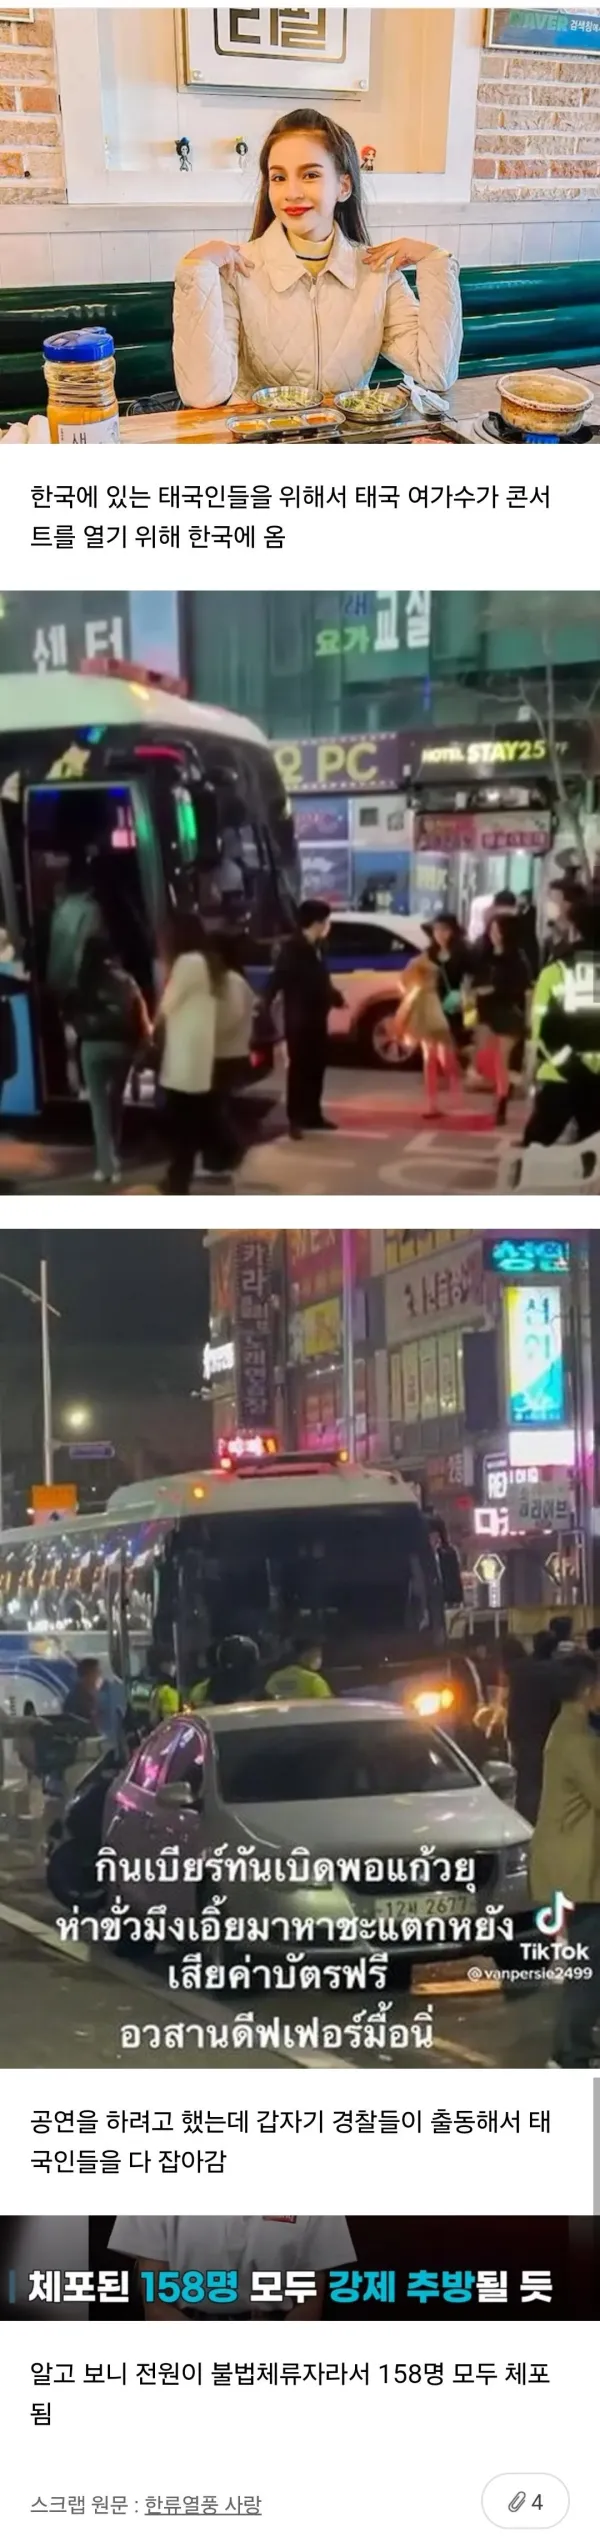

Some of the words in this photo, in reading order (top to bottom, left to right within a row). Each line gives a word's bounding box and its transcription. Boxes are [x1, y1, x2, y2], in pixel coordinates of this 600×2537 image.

[315, 624, 369, 656] 요가
[317, 742, 377, 783] PC
[421, 747, 464, 763] HOTEL
[466, 740, 546, 764] STAY25
[426, 1895, 467, 1914] 2677
